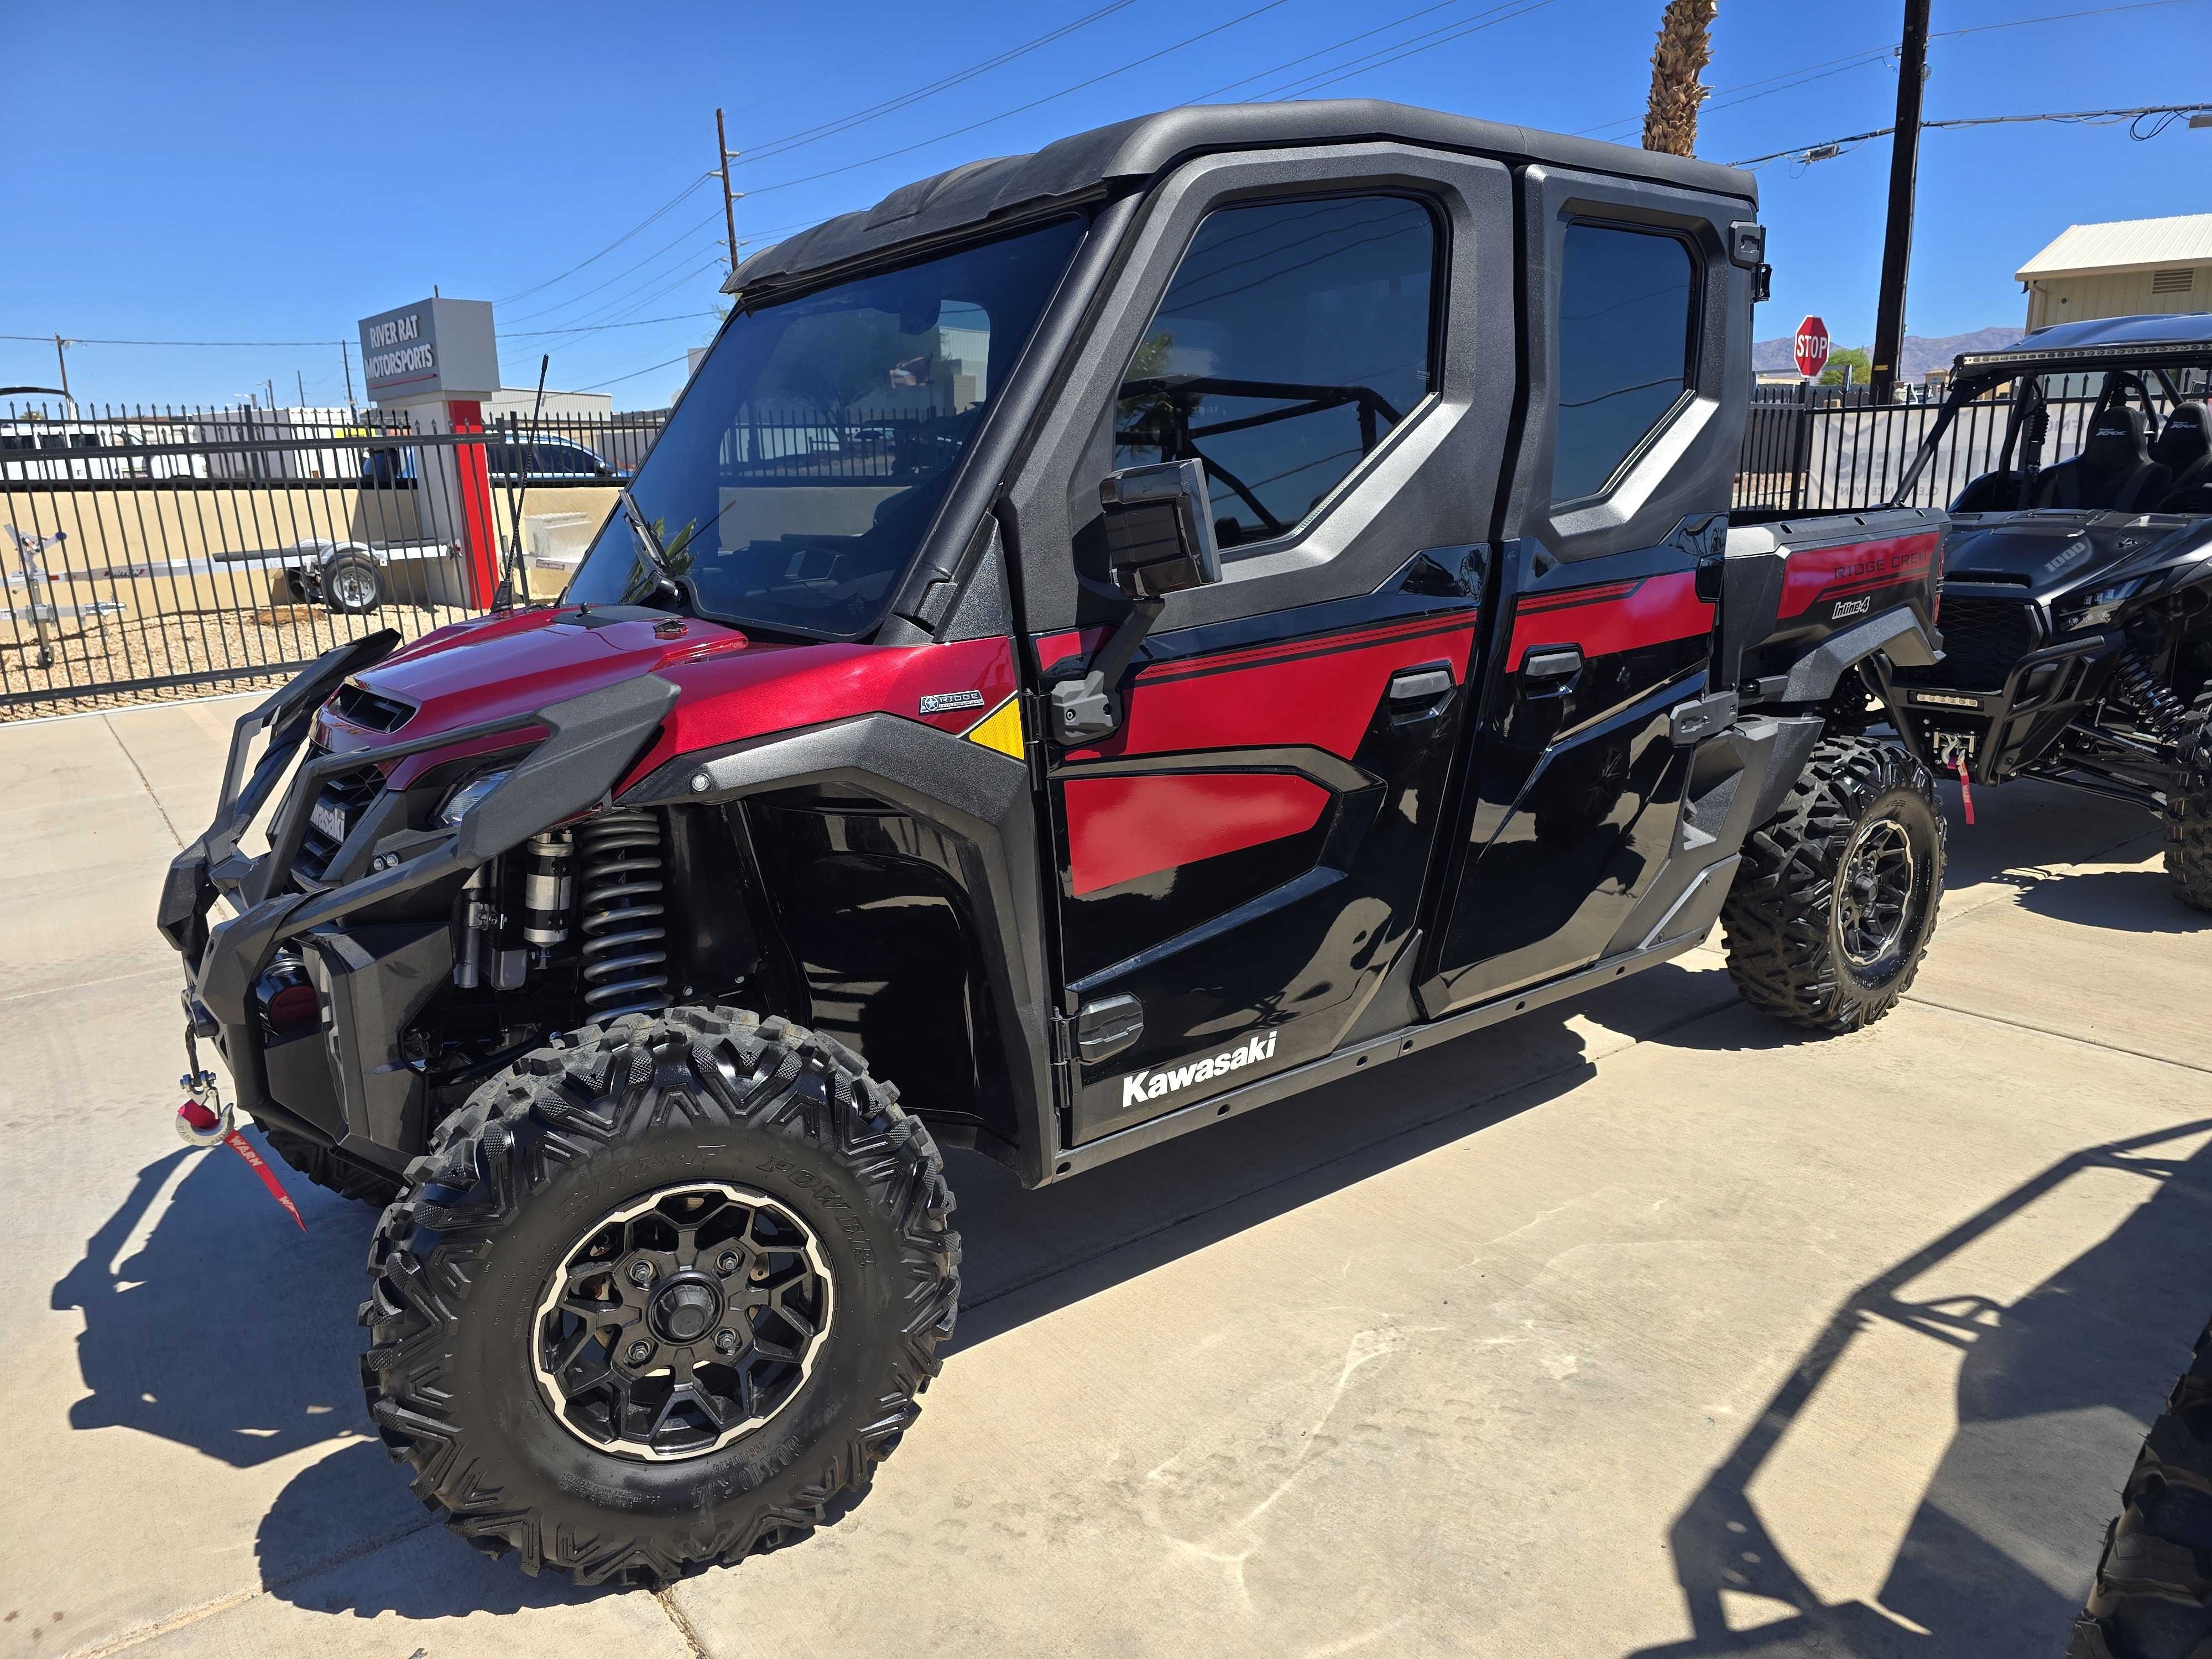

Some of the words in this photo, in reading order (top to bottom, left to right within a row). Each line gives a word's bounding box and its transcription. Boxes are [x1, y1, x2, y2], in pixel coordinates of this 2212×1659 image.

[369, 321, 397, 349] RIVER
[397, 315, 418, 342] RAT
[1797, 335, 1828, 358] STOP
[365, 343, 434, 379] MOTORSPORTS
[1834, 559, 1885, 579] RIDGE
[1891, 550, 1929, 568] CREW
[2044, 542, 2086, 573] 1000
[940, 692, 979, 703] RIDGE
[310, 802, 345, 842] wasaki
[1123, 1030, 1277, 1107] Kawasaki
[229, 1135, 263, 1166] WARN
